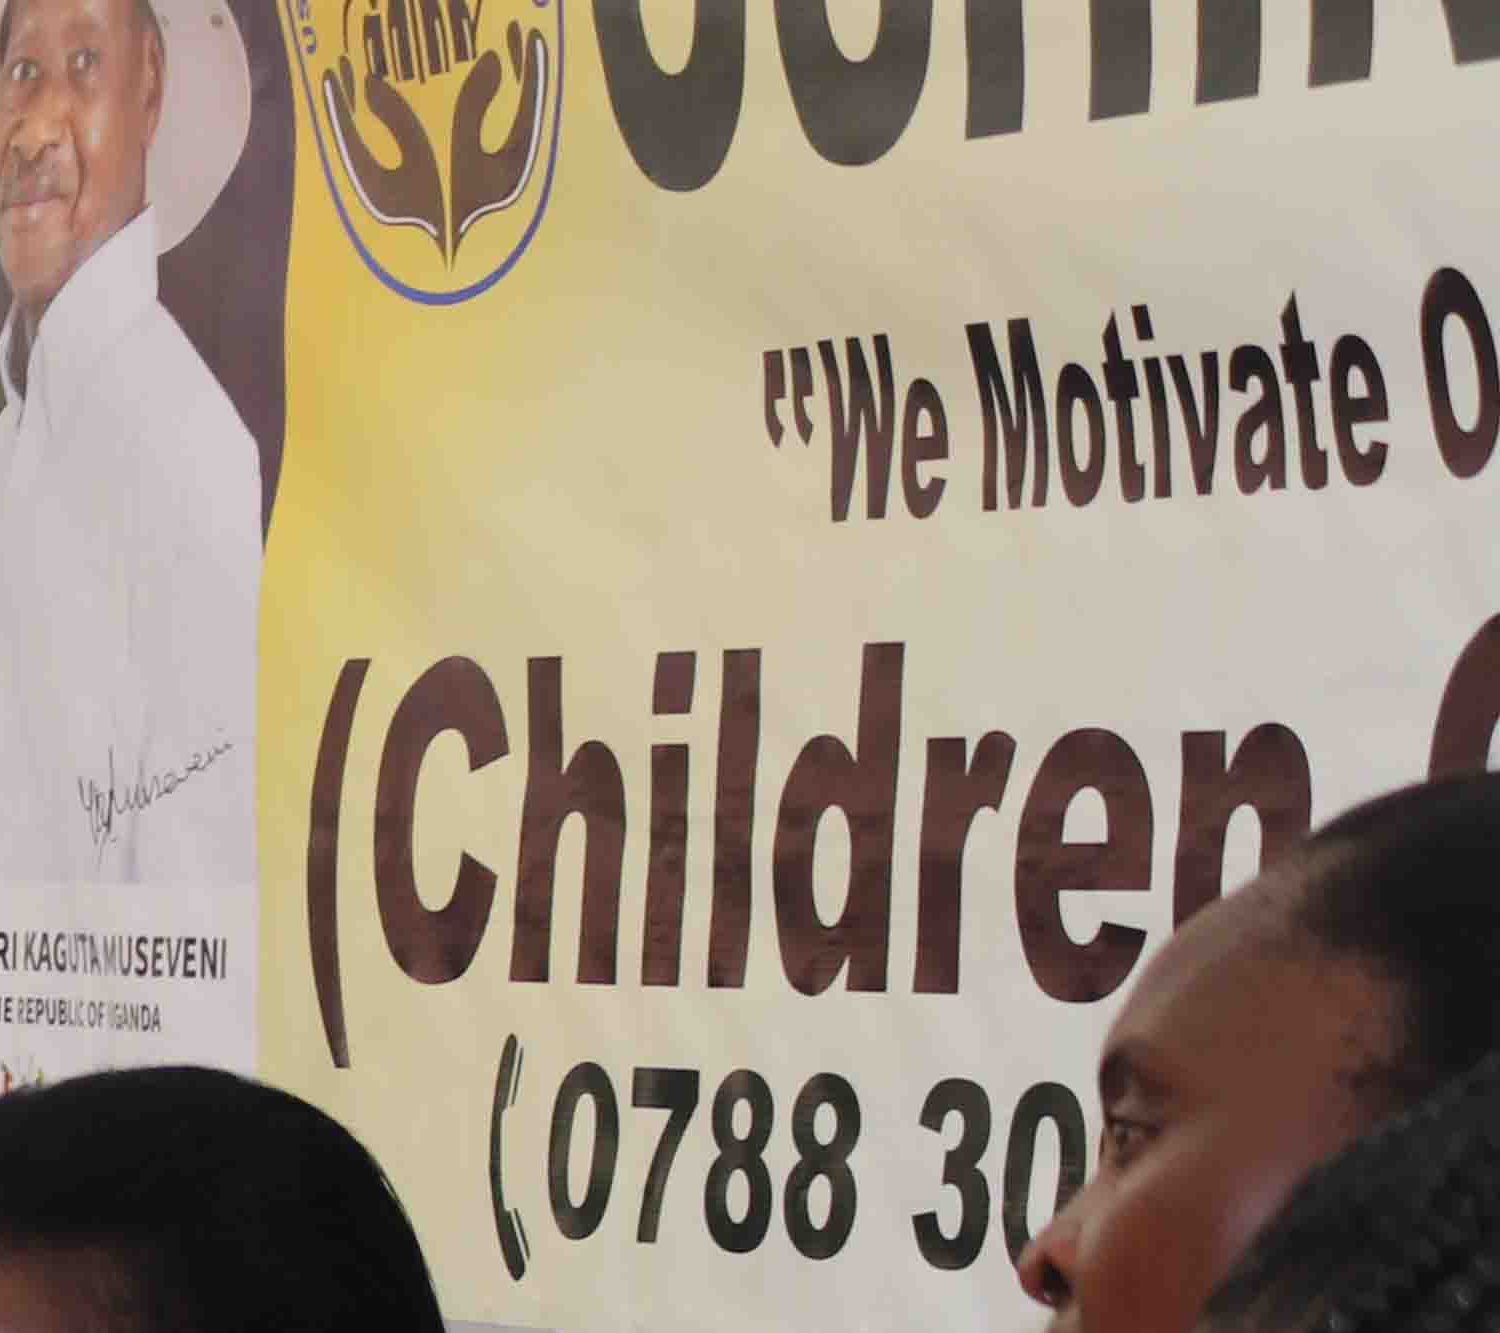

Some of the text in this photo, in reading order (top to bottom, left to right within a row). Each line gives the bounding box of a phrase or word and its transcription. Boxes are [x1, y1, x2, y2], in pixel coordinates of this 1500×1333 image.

[964, 291, 1389, 514] Motivate
[17, 998, 84, 1029] REPUBLIC
[23, 932, 100, 976] KAGUTA
[102, 934, 228, 980] MUSEVENI
[547, 1061, 862, 1261] 0788
